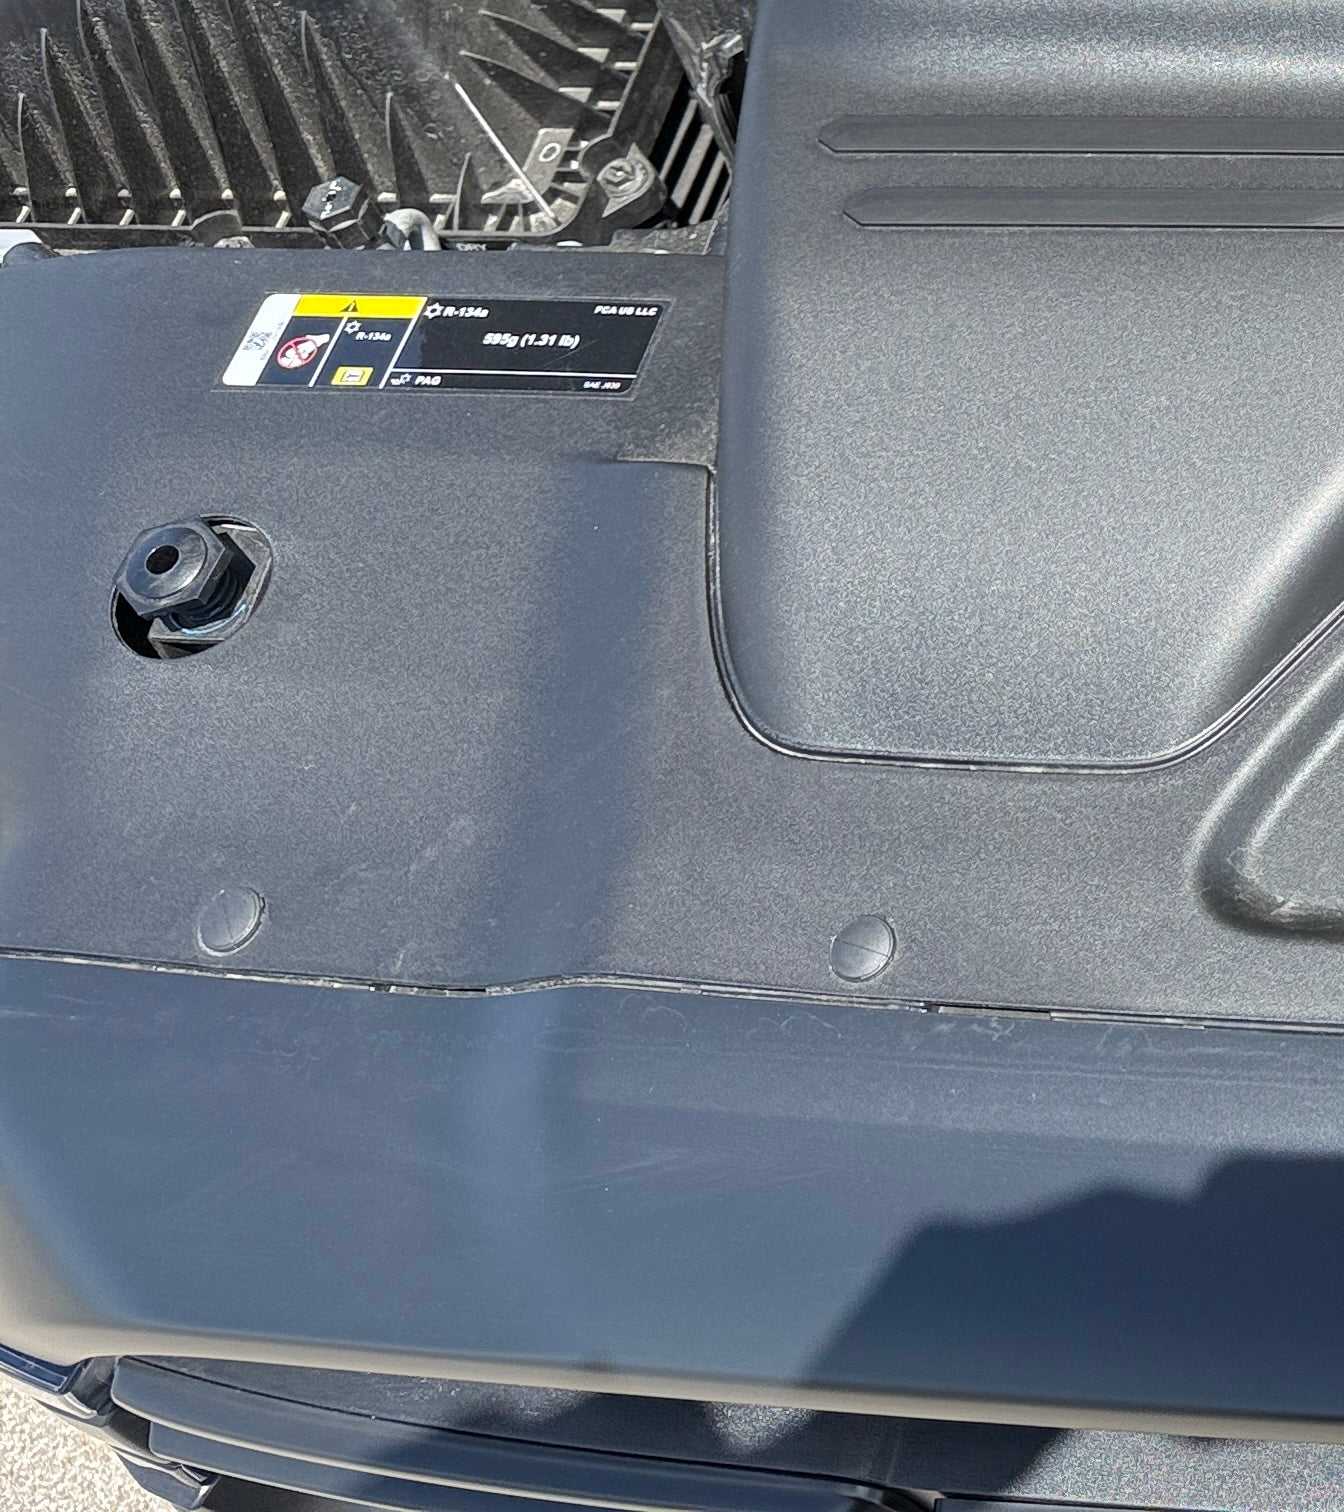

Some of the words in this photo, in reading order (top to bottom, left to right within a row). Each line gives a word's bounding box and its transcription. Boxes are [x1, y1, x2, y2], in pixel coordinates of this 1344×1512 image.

[443, 306, 489, 318] R-134a
[635, 306, 658, 317] LLC
[482, 332, 520, 348] 595g
[519, 333, 557, 348] (1.31
[557, 334, 581, 349] lb)
[414, 375, 442, 386] PAG
